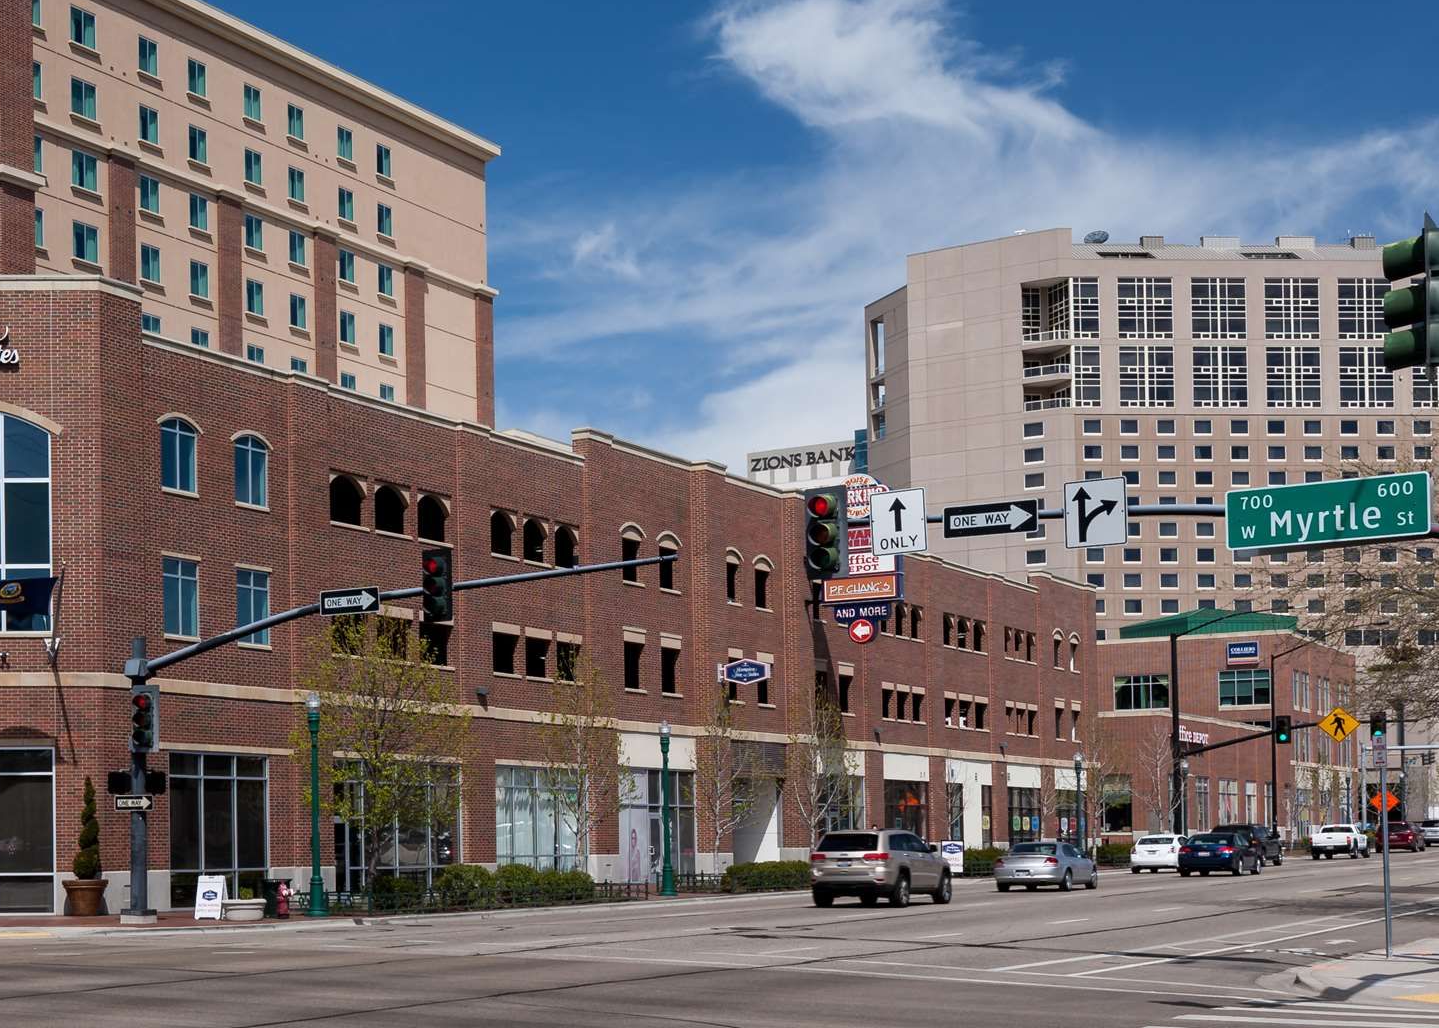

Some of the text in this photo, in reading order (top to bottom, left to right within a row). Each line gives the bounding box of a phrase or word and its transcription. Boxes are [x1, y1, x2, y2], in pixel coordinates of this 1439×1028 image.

[751, 446, 855, 472] ZIONS BANK
[1377, 480, 1414, 498] 600
[1240, 494, 1273, 510] 700
[953, 512, 1010, 528] ONE WAY
[1241, 502, 1415, 542] W Myrtle St
[880, 534, 918, 551] ONLY
[849, 555, 879, 565] ffice
[849, 564, 879, 573] EPOT
[846, 582, 891, 595] CHANG'S
[326, 596, 362, 607] ONE WAY
[835, 605, 888, 619] AND MORE
[1178, 725, 1192, 742] ffice
